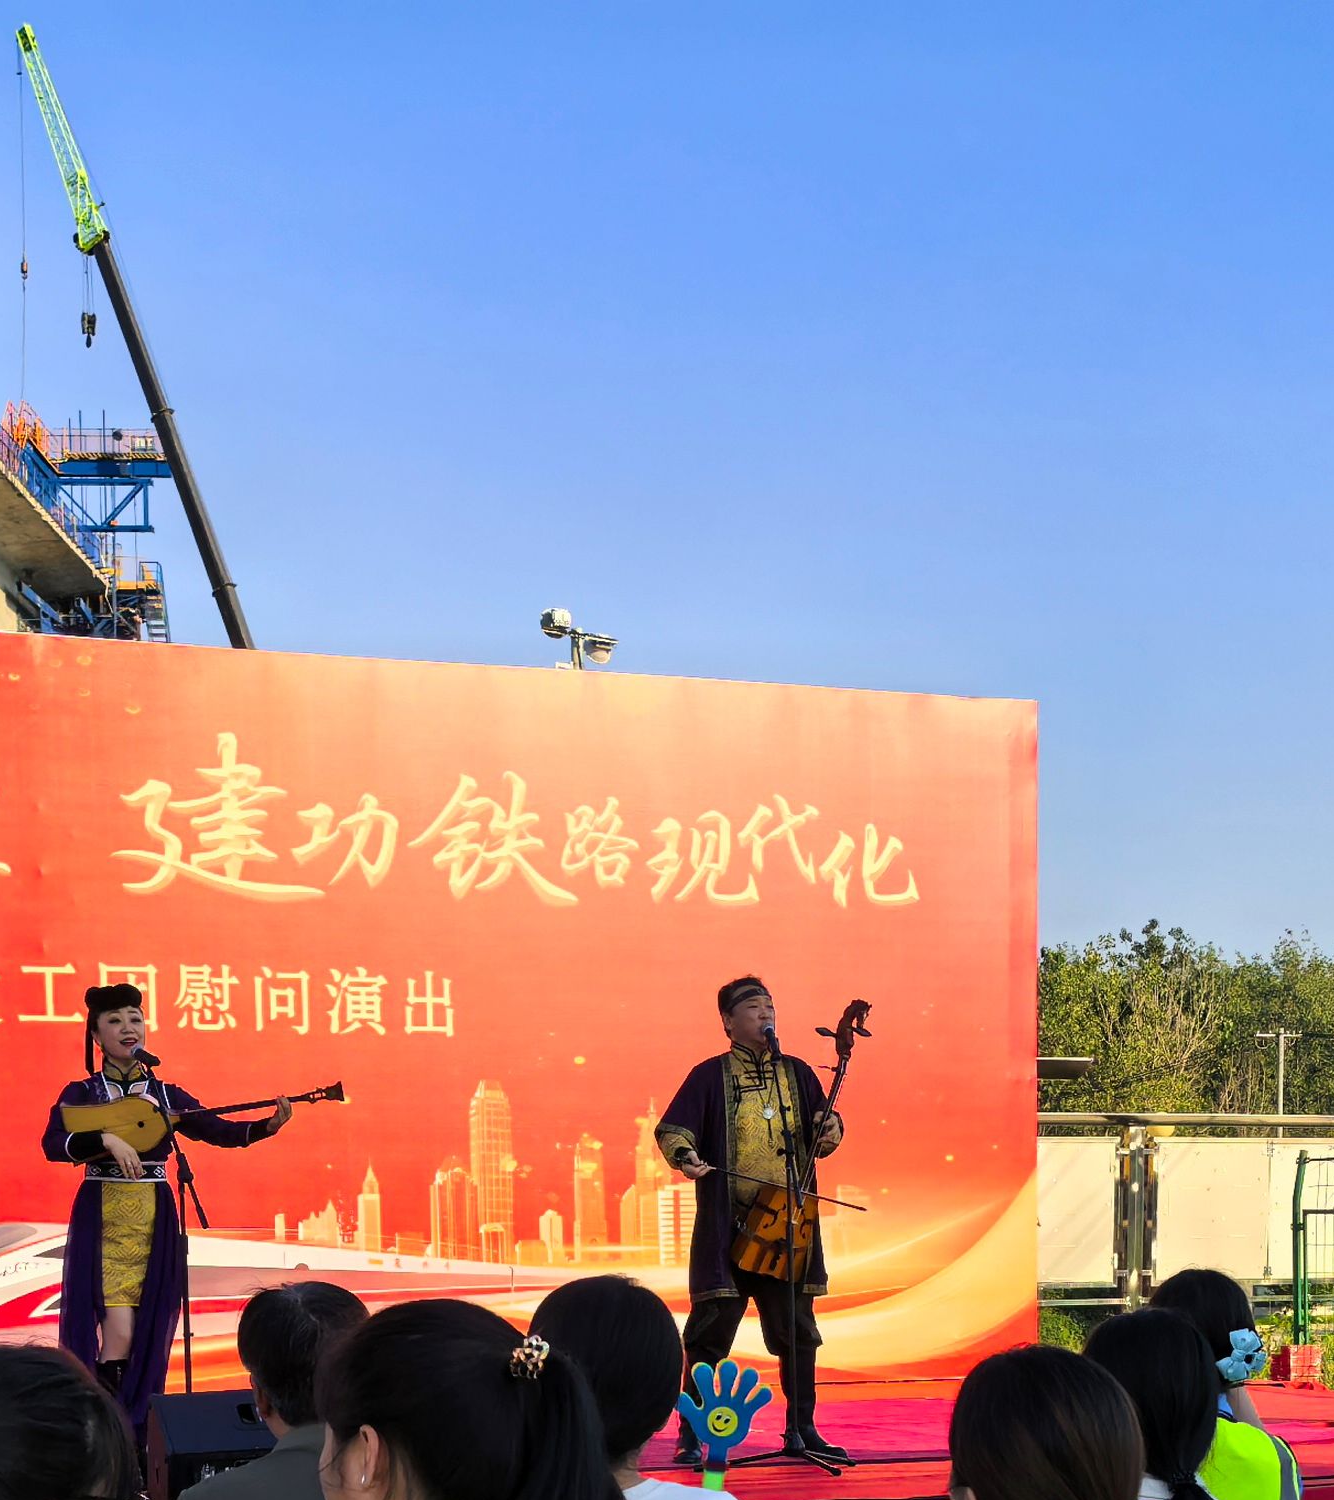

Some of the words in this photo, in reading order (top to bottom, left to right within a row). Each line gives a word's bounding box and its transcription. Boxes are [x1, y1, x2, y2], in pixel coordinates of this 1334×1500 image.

[110, 731, 920, 908] 建功铁路现代化
